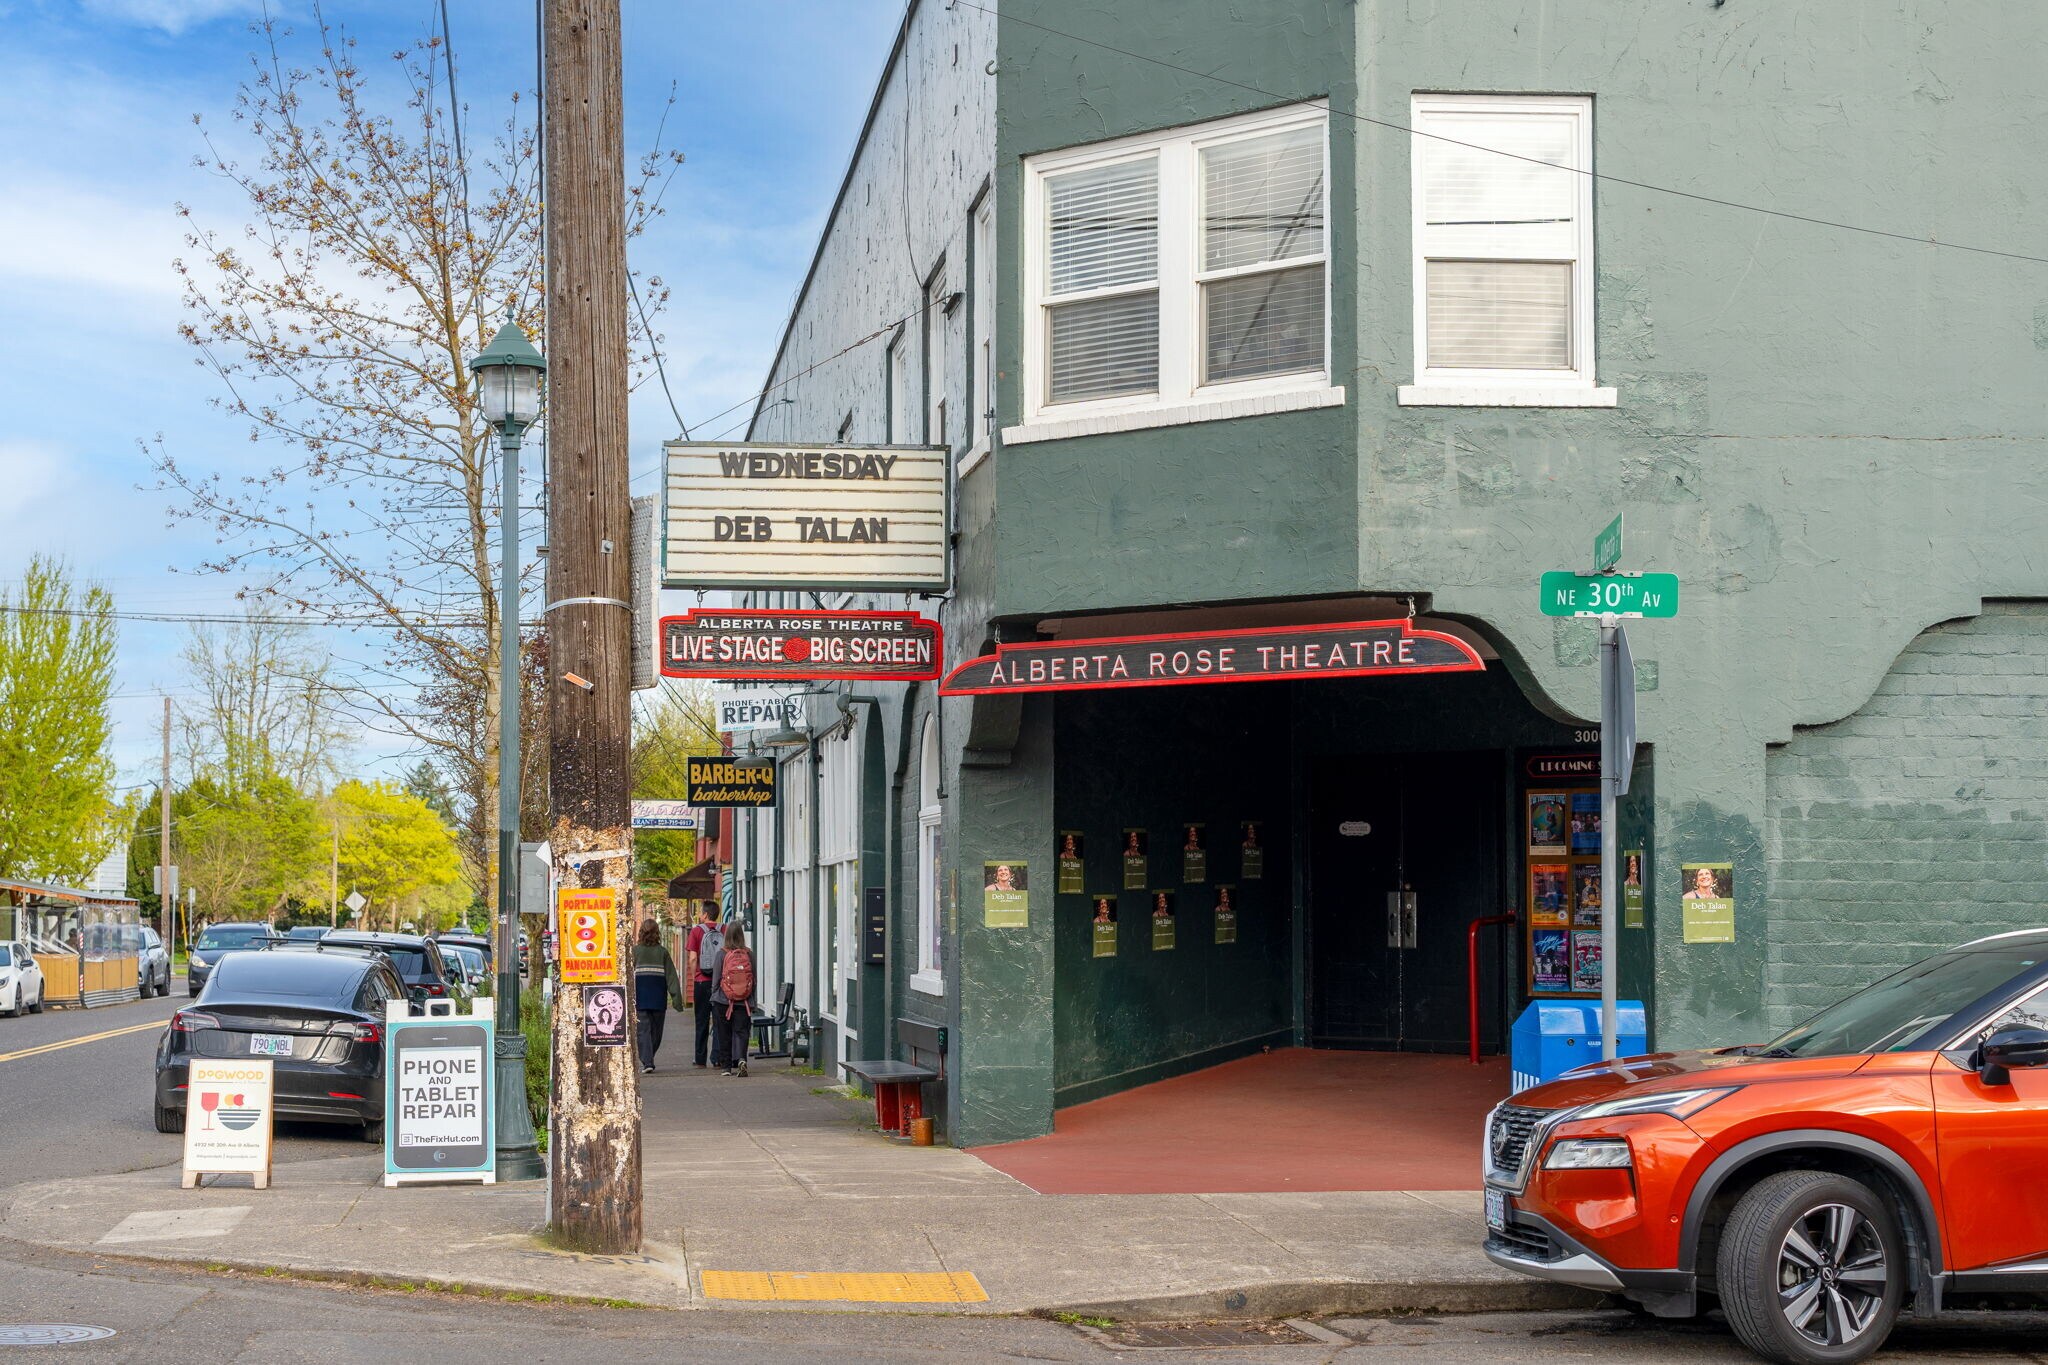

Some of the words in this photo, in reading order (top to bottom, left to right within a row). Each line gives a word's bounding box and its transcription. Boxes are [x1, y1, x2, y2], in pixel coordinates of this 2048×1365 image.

[719, 452, 898, 480] WEDNESDAY
[714, 516, 773, 543] DEB
[796, 516, 888, 543] TALAN
[1557, 589, 1575, 606] NE
[1588, 583, 1634, 607] 30th
[699, 618, 773, 630] ALBERTA
[779, 619, 822, 630] ROSE
[828, 620, 903, 631] THEATRE
[671, 635, 714, 662] LIVE
[719, 635, 784, 662] STAGE
[810, 637, 845, 663] BIG
[850, 638, 931, 664] SCREEN
[990, 654, 1129, 684] ALBERTA
[1149, 648, 1236, 677] ROSE
[1257, 639, 1415, 670] THEATRE
[722, 705, 798, 724] REPAIR
[1575, 730, 1601, 742] 300
[690, 763, 774, 785] BARBER-Q
[692, 787, 772, 805] barbershop
[563, 899, 612, 910] PORTLAND
[565, 959, 613, 971] PANORAMA
[253, 1038, 269, 1050] 790
[274, 1039, 290, 1051] NBL
[404, 1059, 477, 1075] PHONE
[428, 1076, 452, 1085] AND
[402, 1086, 480, 1102] TABLET
[403, 1104, 476, 1119] REPAIR
[414, 1135, 480, 1144] TheFixHut.com
